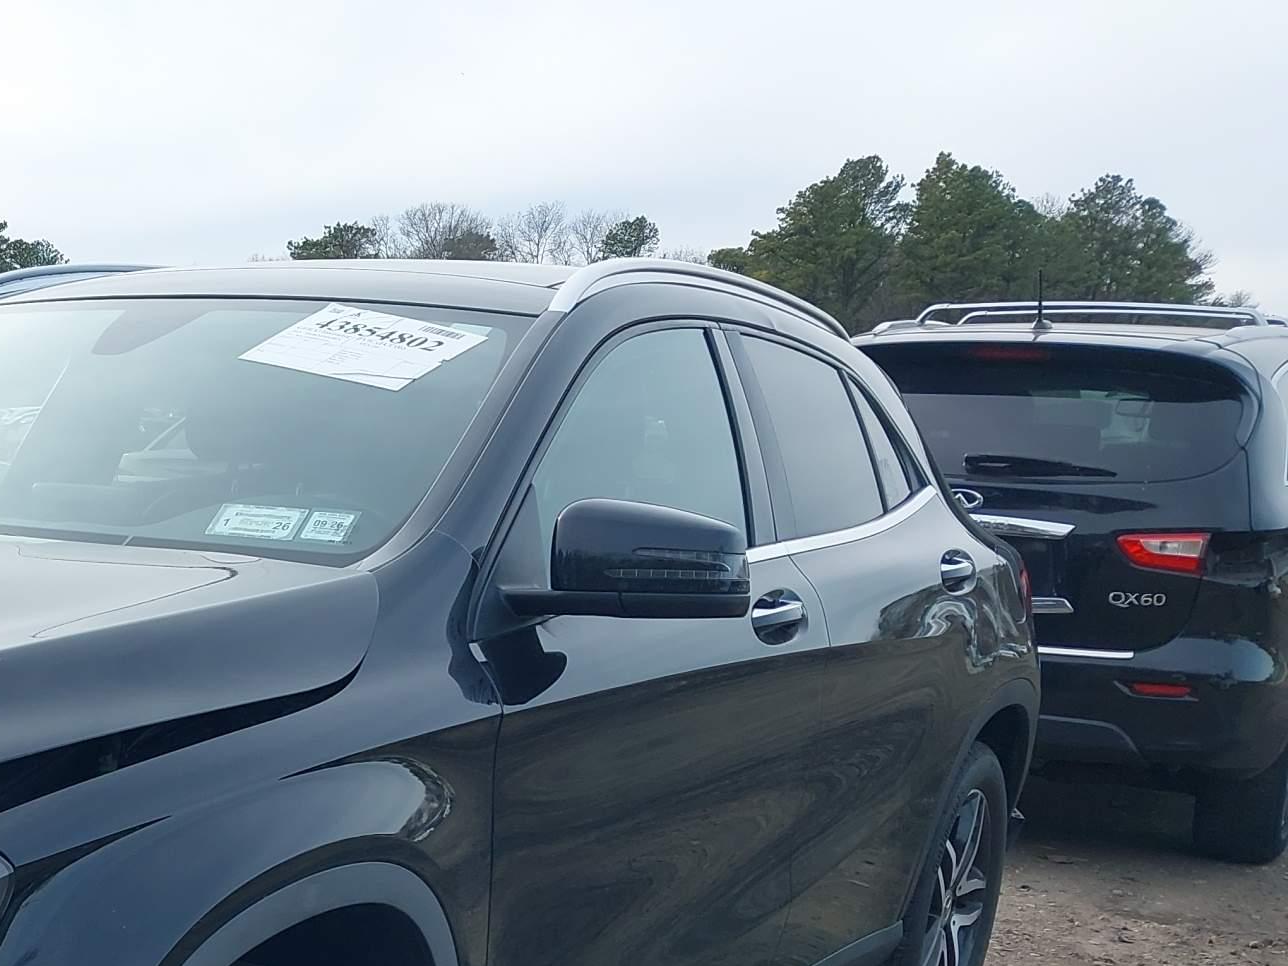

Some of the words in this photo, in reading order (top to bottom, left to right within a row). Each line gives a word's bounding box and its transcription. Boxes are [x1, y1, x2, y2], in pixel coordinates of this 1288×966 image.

[315, 318, 444, 352] 43854802
[272, 521, 292, 531] 26
[1108, 591, 1166, 608] QX60
